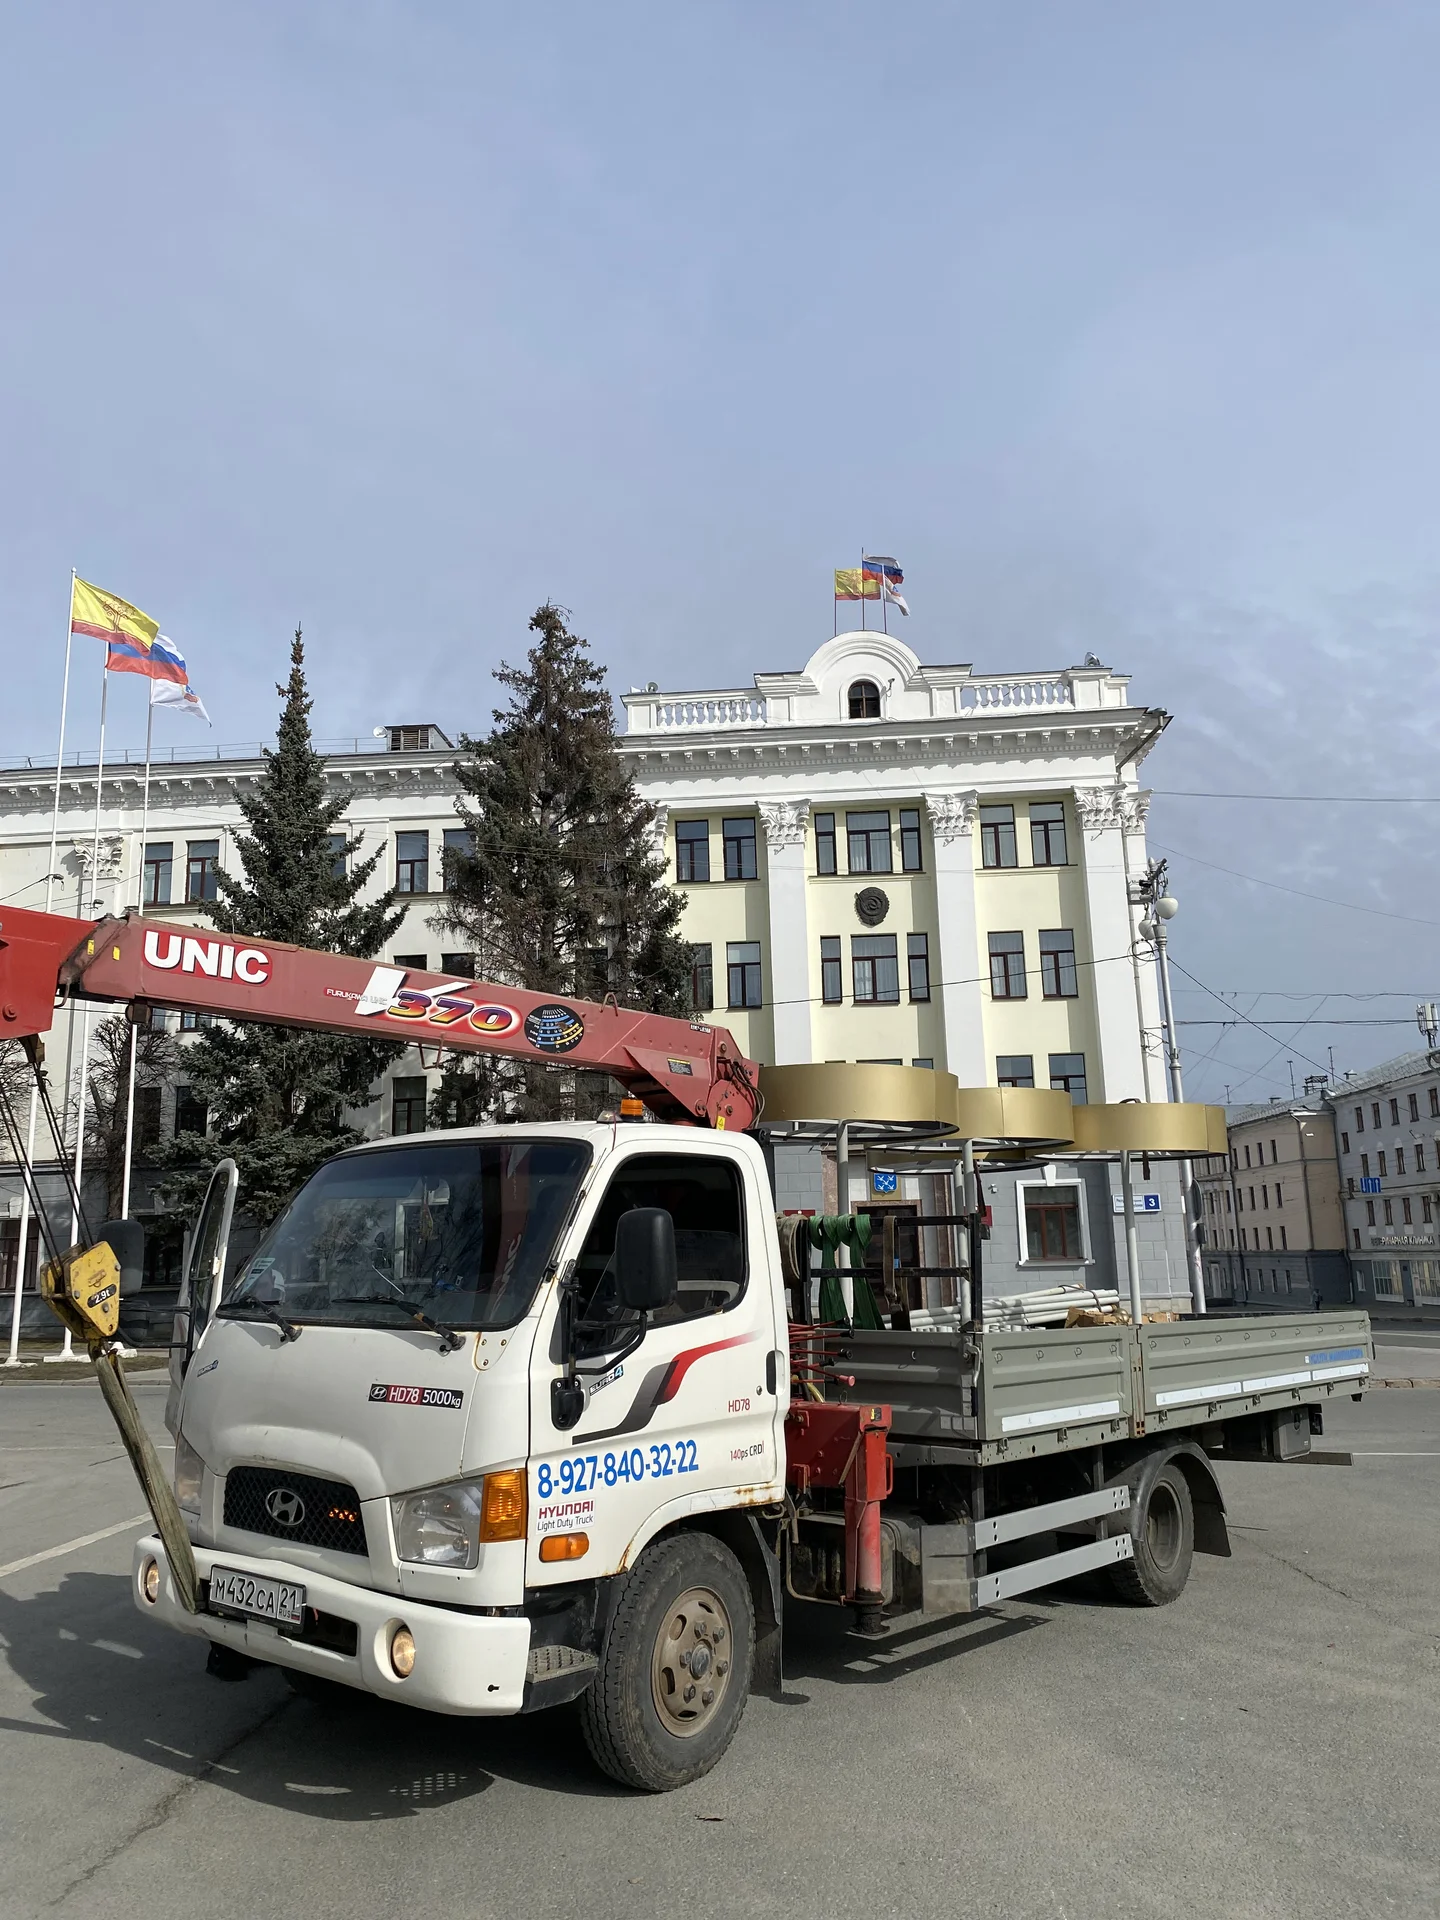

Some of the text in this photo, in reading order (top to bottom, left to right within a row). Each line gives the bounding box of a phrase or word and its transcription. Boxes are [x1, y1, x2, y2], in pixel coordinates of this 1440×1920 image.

[144, 930, 269, 984] UNIC
[326, 988, 368, 1003] FURUKAWA
[1148, 1198, 1156, 1207] 3
[94, 1289, 111, 1304] 2.9t
[389, 1387, 461, 1408] HD78 5000kg
[728, 1398, 751, 1413] HD78
[730, 1448, 748, 1461] 140ps
[537, 1439, 699, 1499] 8-927-840-32-22
[538, 1500, 594, 1520] HYUNDAI
[537, 1515, 593, 1533] Light Duty Truck
[280, 1587, 297, 1610] 21
[279, 1608, 291, 1618] RUS
